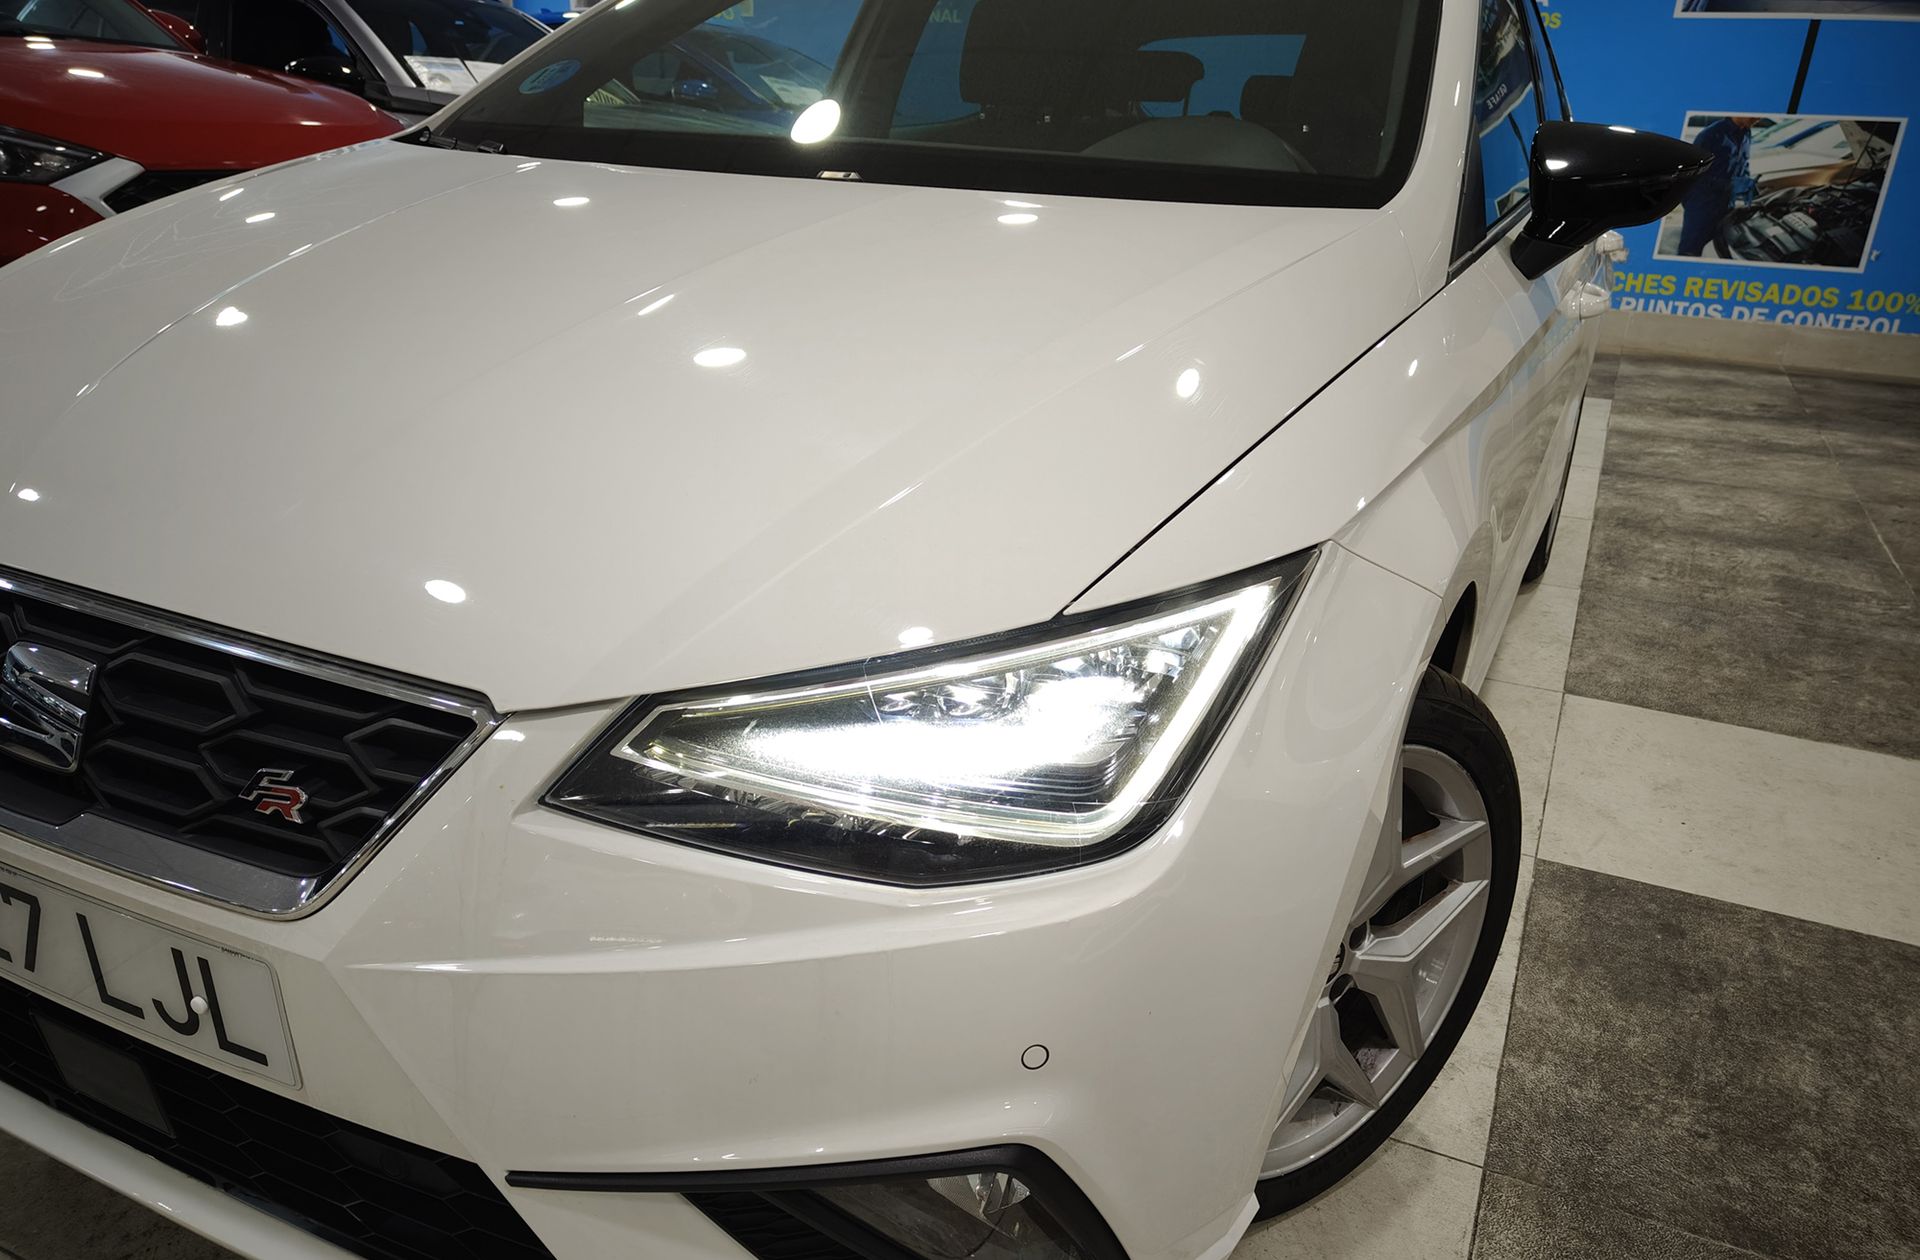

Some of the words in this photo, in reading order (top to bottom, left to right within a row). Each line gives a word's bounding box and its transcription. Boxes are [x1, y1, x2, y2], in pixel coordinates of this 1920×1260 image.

[1684, 277, 1840, 309] REVISADOS
[1846, 289, 1920, 315] 100%
[238, 768, 305, 824] FR
[76, 912, 269, 1067] LJL
